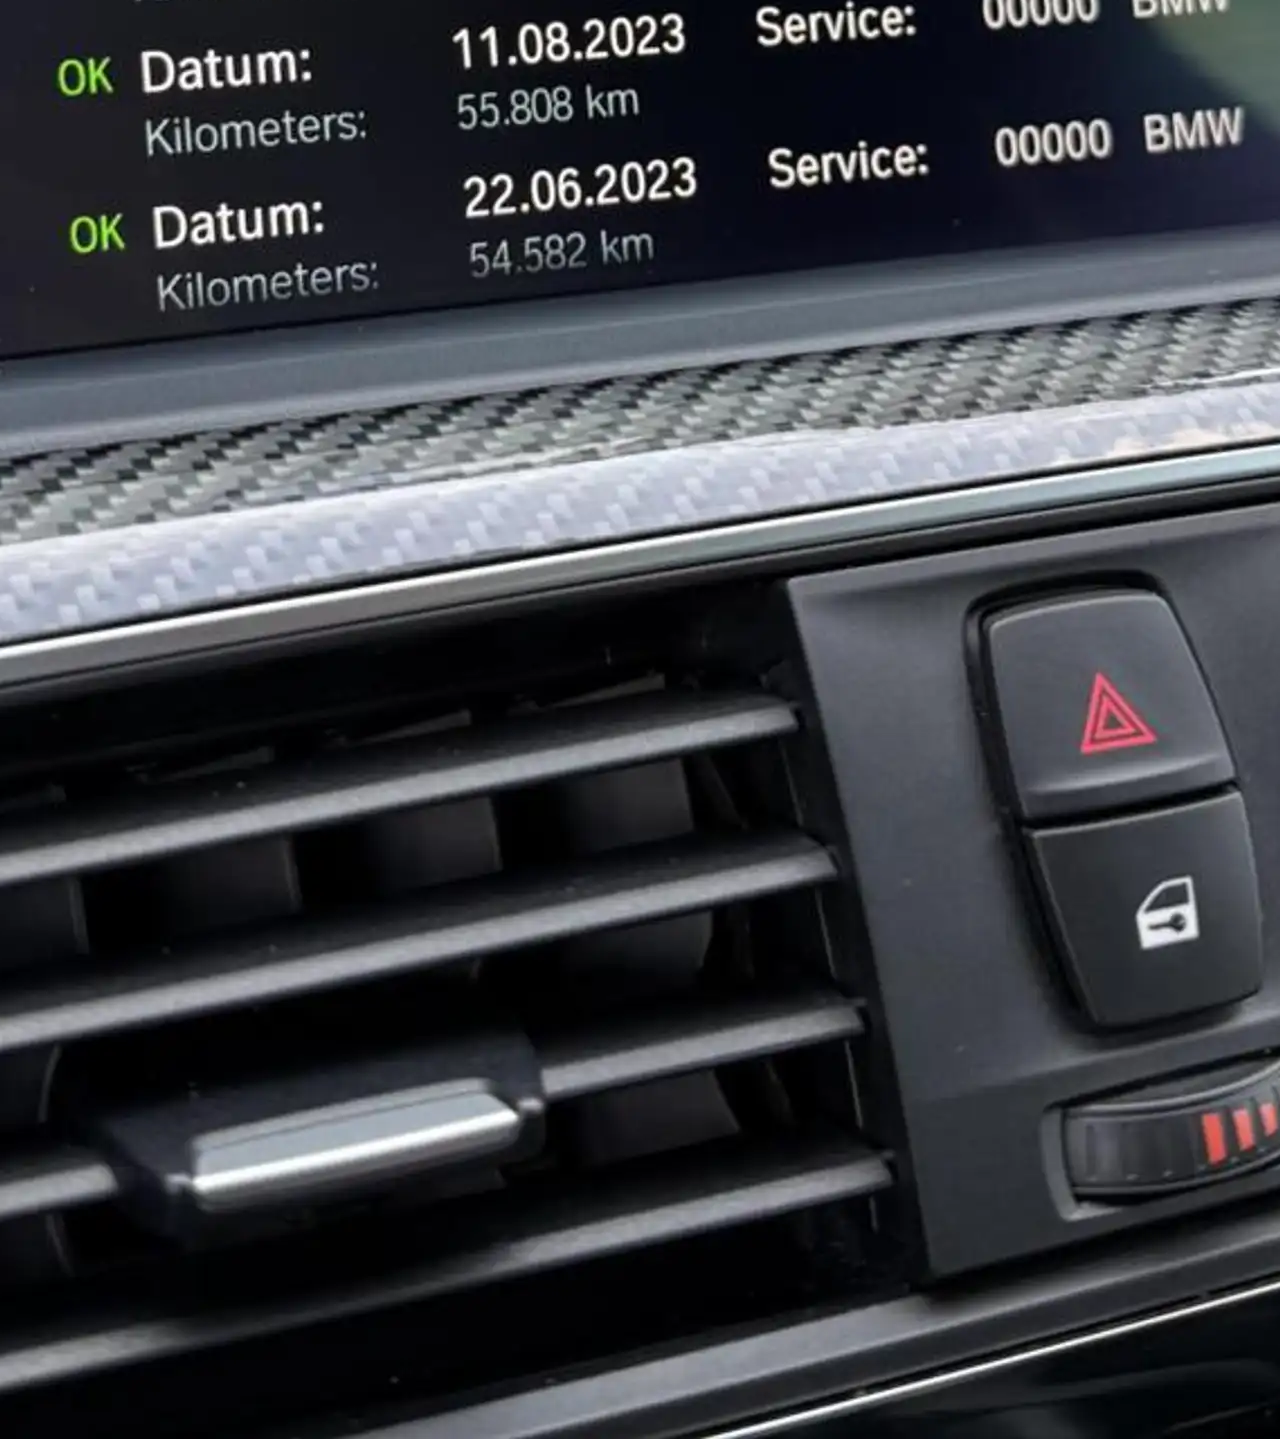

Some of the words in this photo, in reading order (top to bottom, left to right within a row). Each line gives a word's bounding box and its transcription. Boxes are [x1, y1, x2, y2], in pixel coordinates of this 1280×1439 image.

[59, 58, 113, 96] OK
[141, 49, 312, 94] Datum:
[452, 12, 686, 70] 11.08.2023
[756, 1, 916, 47] Service:
[146, 109, 366, 157] Kilometers:
[457, 90, 574, 131] 55.808
[586, 84, 639, 118] km
[70, 215, 125, 253] OK
[153, 203, 324, 250] Datum:
[464, 157, 697, 219] 22.06.2023
[768, 143, 928, 188] Service:
[995, 118, 1111, 166] 00000
[1144, 107, 1244, 153] BMW
[158, 262, 378, 312] Kilometers:
[469, 234, 587, 279] 54.582
[601, 229, 654, 264] km
